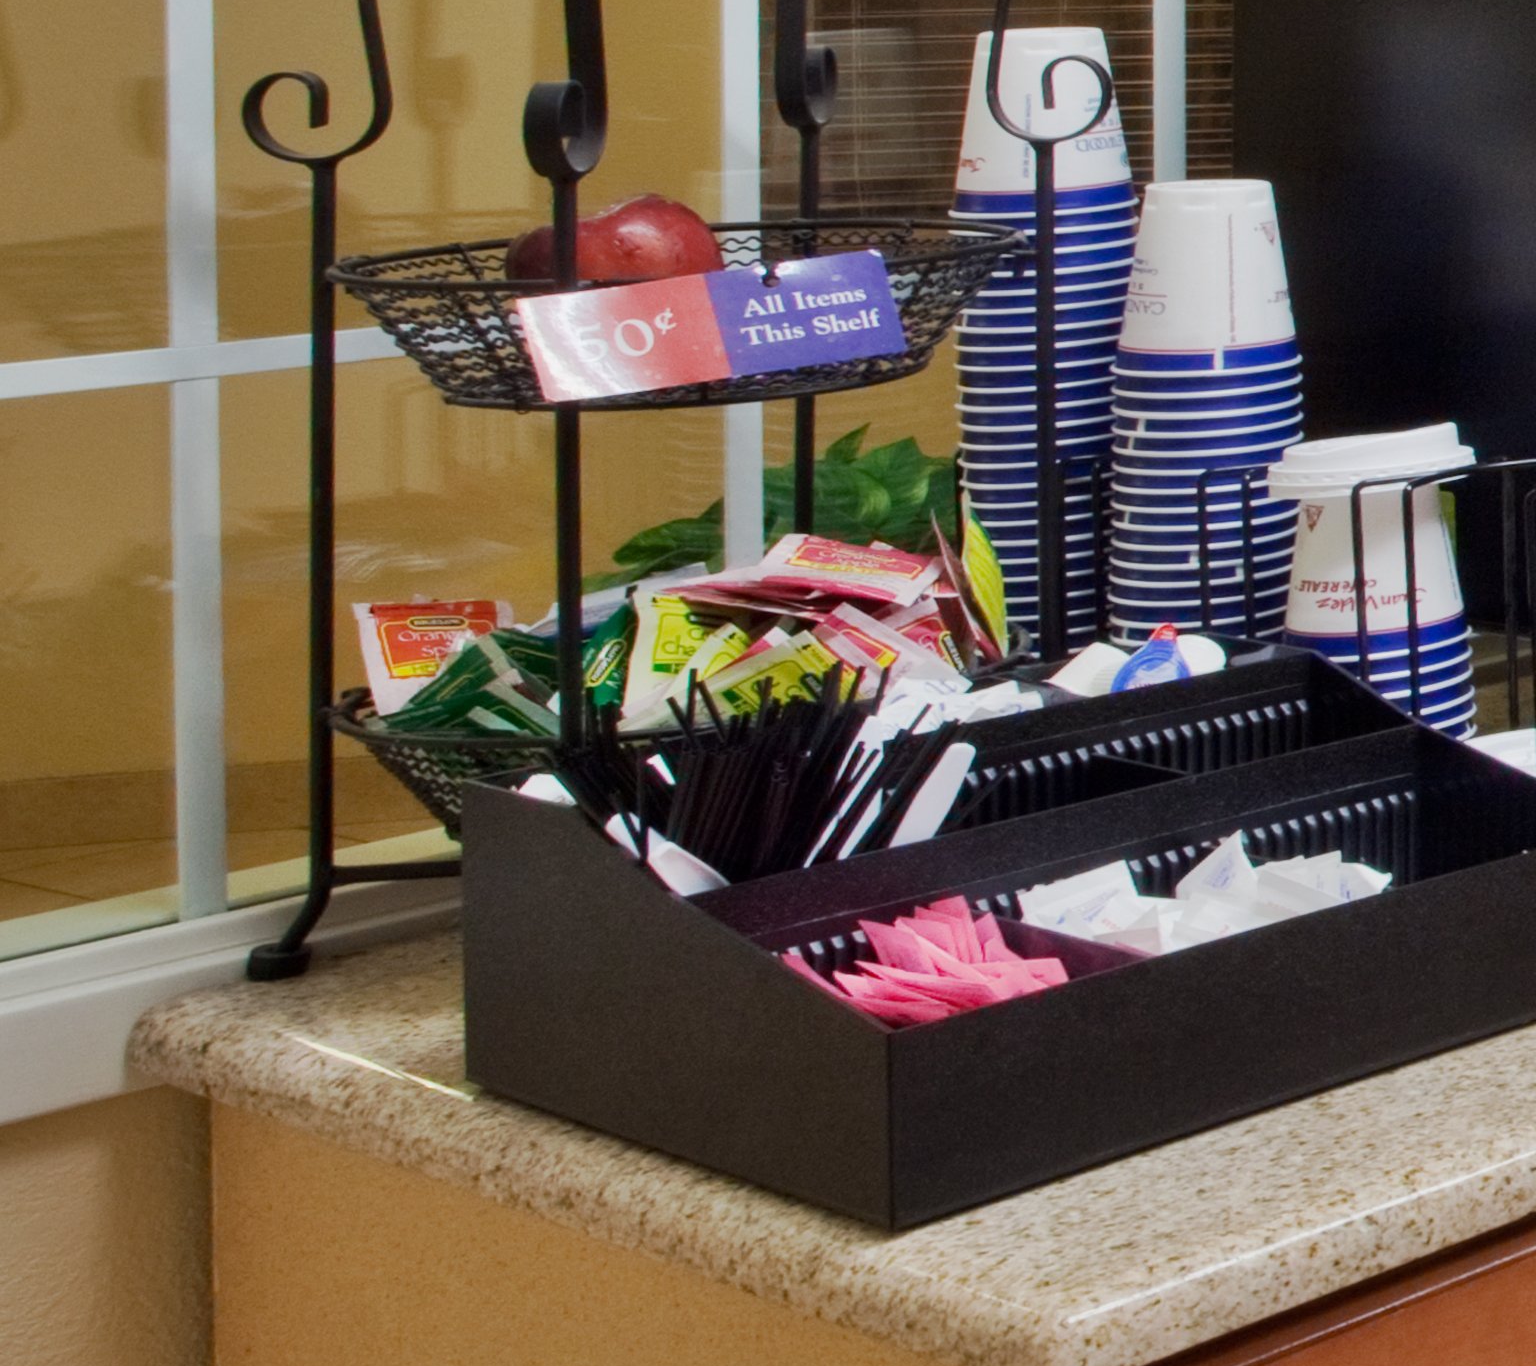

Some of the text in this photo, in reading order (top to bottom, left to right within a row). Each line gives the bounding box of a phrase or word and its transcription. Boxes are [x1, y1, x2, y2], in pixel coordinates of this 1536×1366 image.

[743, 284, 867, 319] All Items
[578, 307, 677, 365] 50¢
[740, 308, 881, 348] This Shelf
